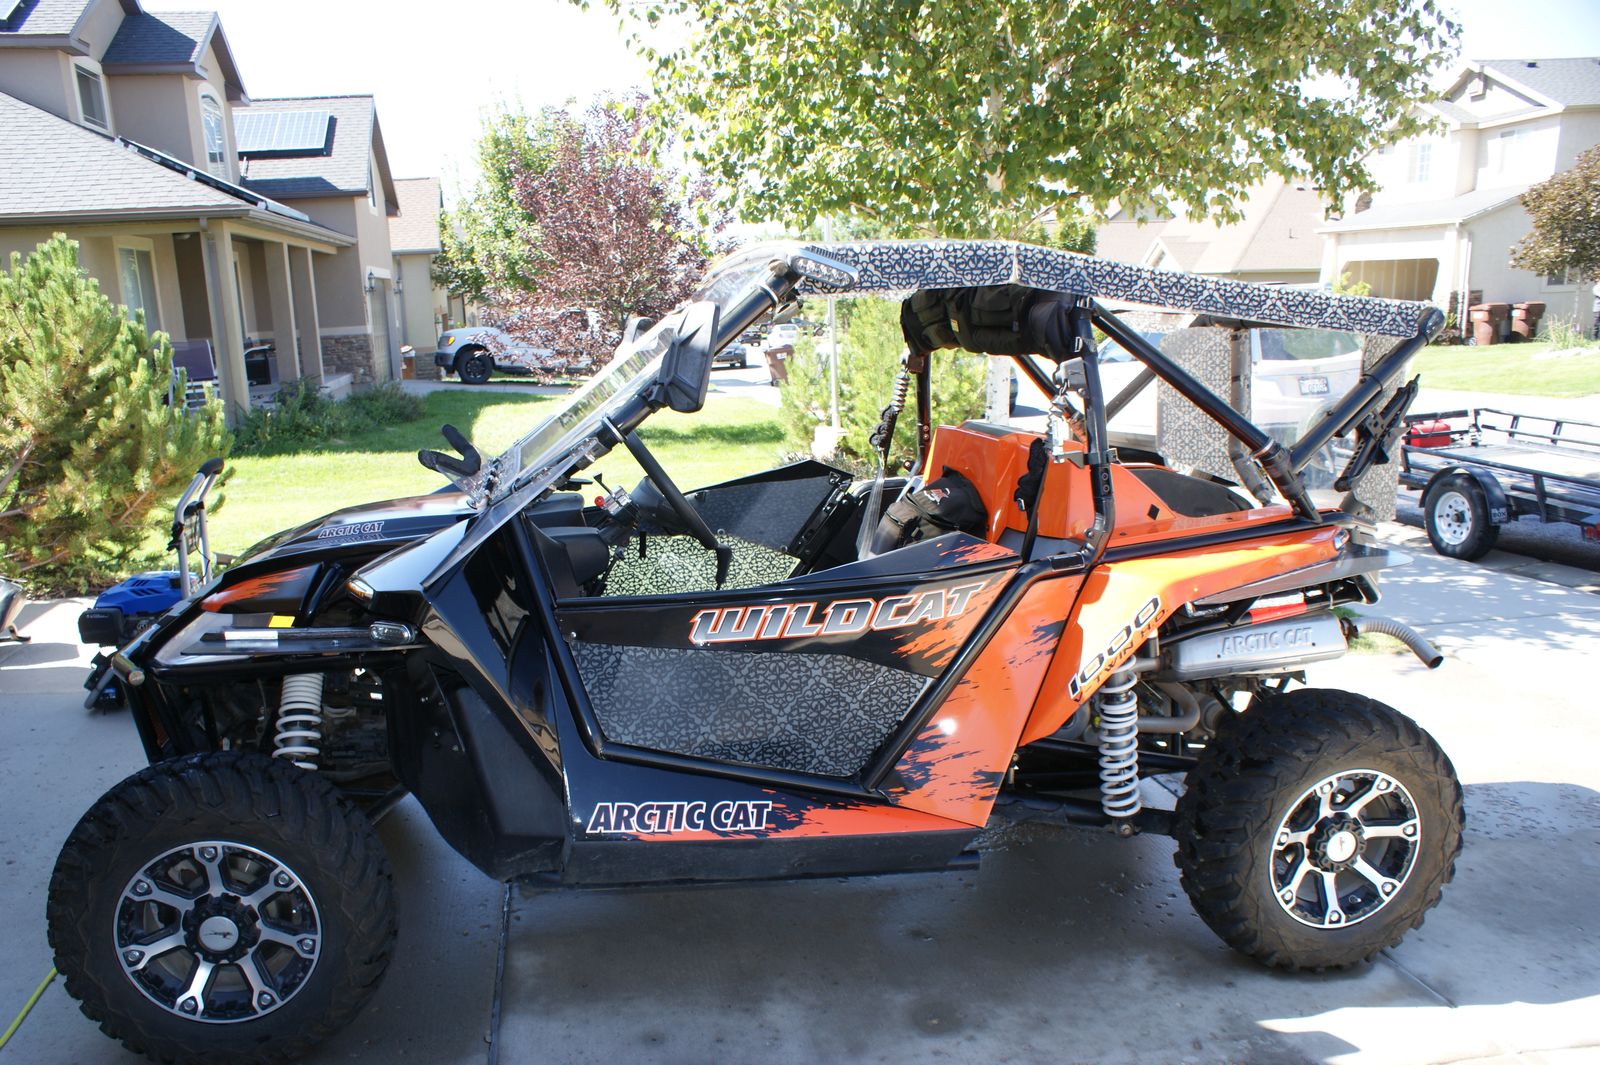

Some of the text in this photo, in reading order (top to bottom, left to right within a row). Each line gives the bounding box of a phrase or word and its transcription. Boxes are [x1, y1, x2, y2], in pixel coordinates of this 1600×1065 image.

[318, 521, 385, 539] ARCTIC CAT
[689, 582, 987, 645] WILDCAT
[1068, 595, 1161, 699] 1000
[1221, 626, 1313, 656] ARCTIC CAT
[586, 800, 773, 834] ARCTIC CAT
